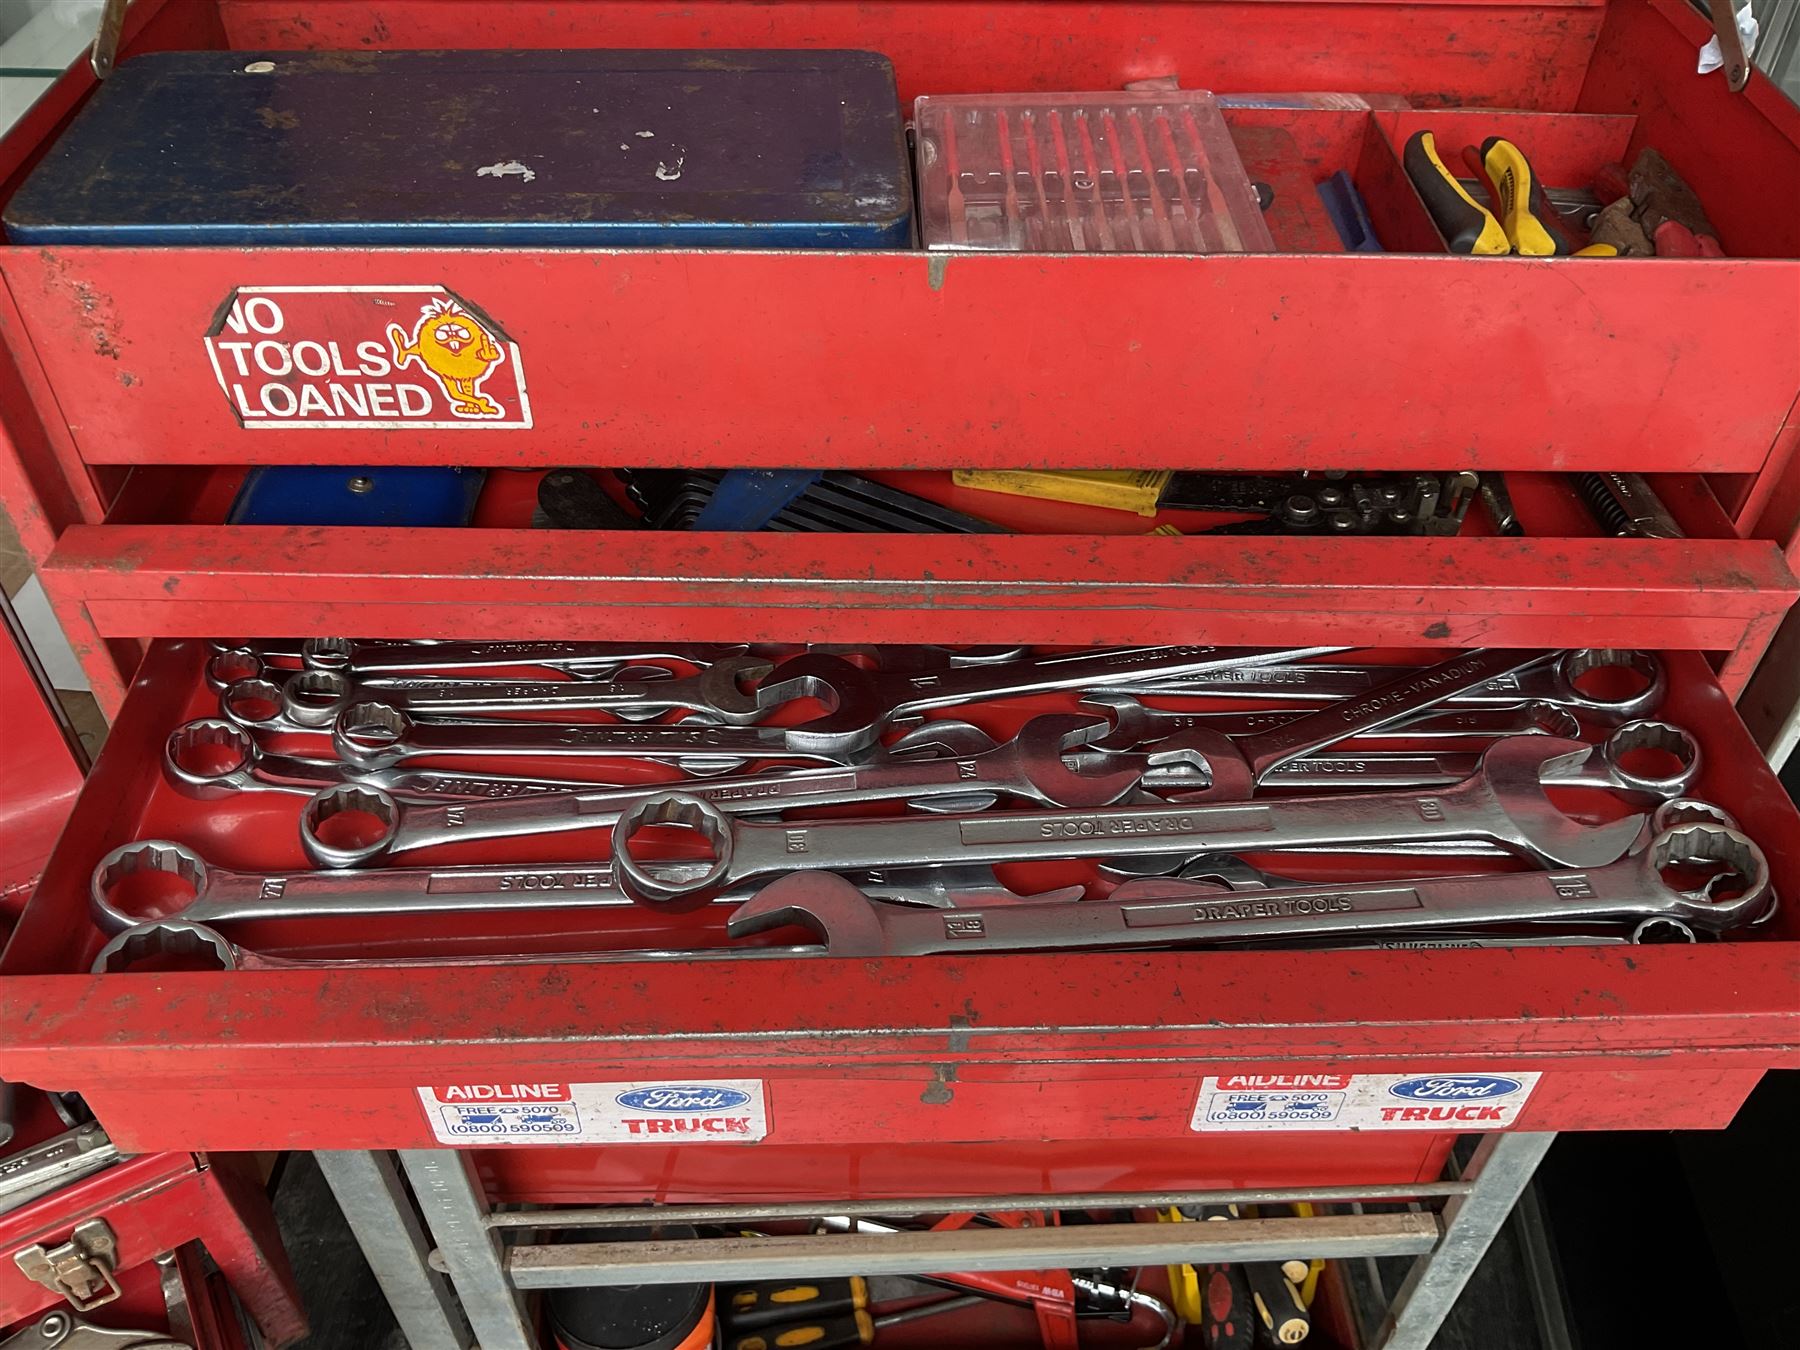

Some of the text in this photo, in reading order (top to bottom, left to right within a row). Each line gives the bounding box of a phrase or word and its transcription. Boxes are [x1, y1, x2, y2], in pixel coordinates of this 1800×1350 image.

[226, 297, 285, 335] NO
[218, 340, 392, 377] TOOLS
[234, 383, 433, 418] LOANED
[1312, 761, 1367, 773] TOOLS
[1040, 816, 1193, 838] DRAPER TOOLS
[788, 831, 805, 852] 30
[500, 875, 565, 890] TOOLS
[1193, 896, 1354, 922] DRAPER TOOLS
[1226, 1074, 1343, 1087] AIDLINE
[1415, 1077, 1496, 1097] Ford
[445, 1083, 562, 1100] AIDLINE
[645, 1088, 726, 1108] Ford
[1228, 1092, 1328, 1103] FREE 5070
[457, 1105, 559, 1115] FREE 5070
[1210, 1109, 1332, 1122] (0800) 590509
[1380, 1105, 1507, 1122] TRUCK
[450, 1122, 575, 1134] (0800) 590509
[621, 1116, 752, 1134] TRUCK
